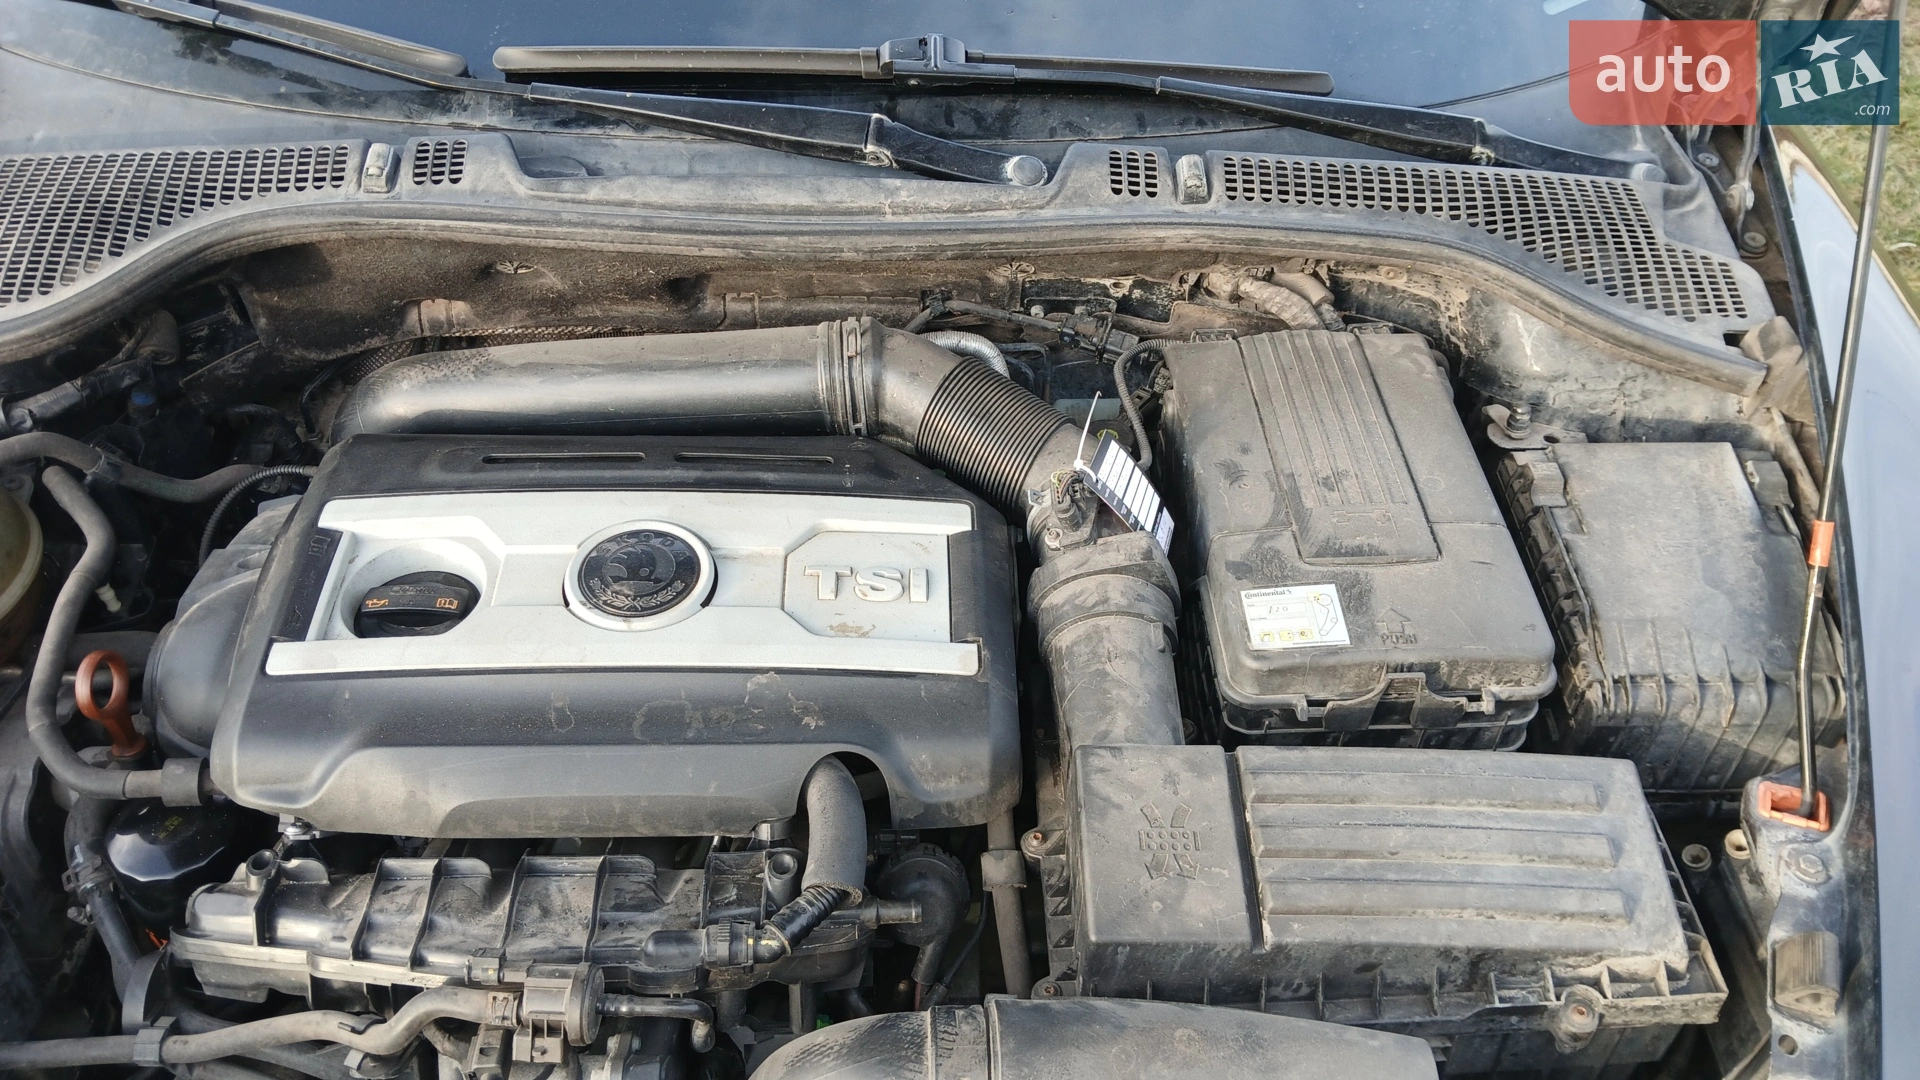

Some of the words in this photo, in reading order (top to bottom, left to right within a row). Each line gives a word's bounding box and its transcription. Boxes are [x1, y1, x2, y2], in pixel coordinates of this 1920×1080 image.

[804, 565, 929, 603] TSI
[1244, 589, 1286, 600] Continental
[1381, 633, 1418, 646] PUSH
